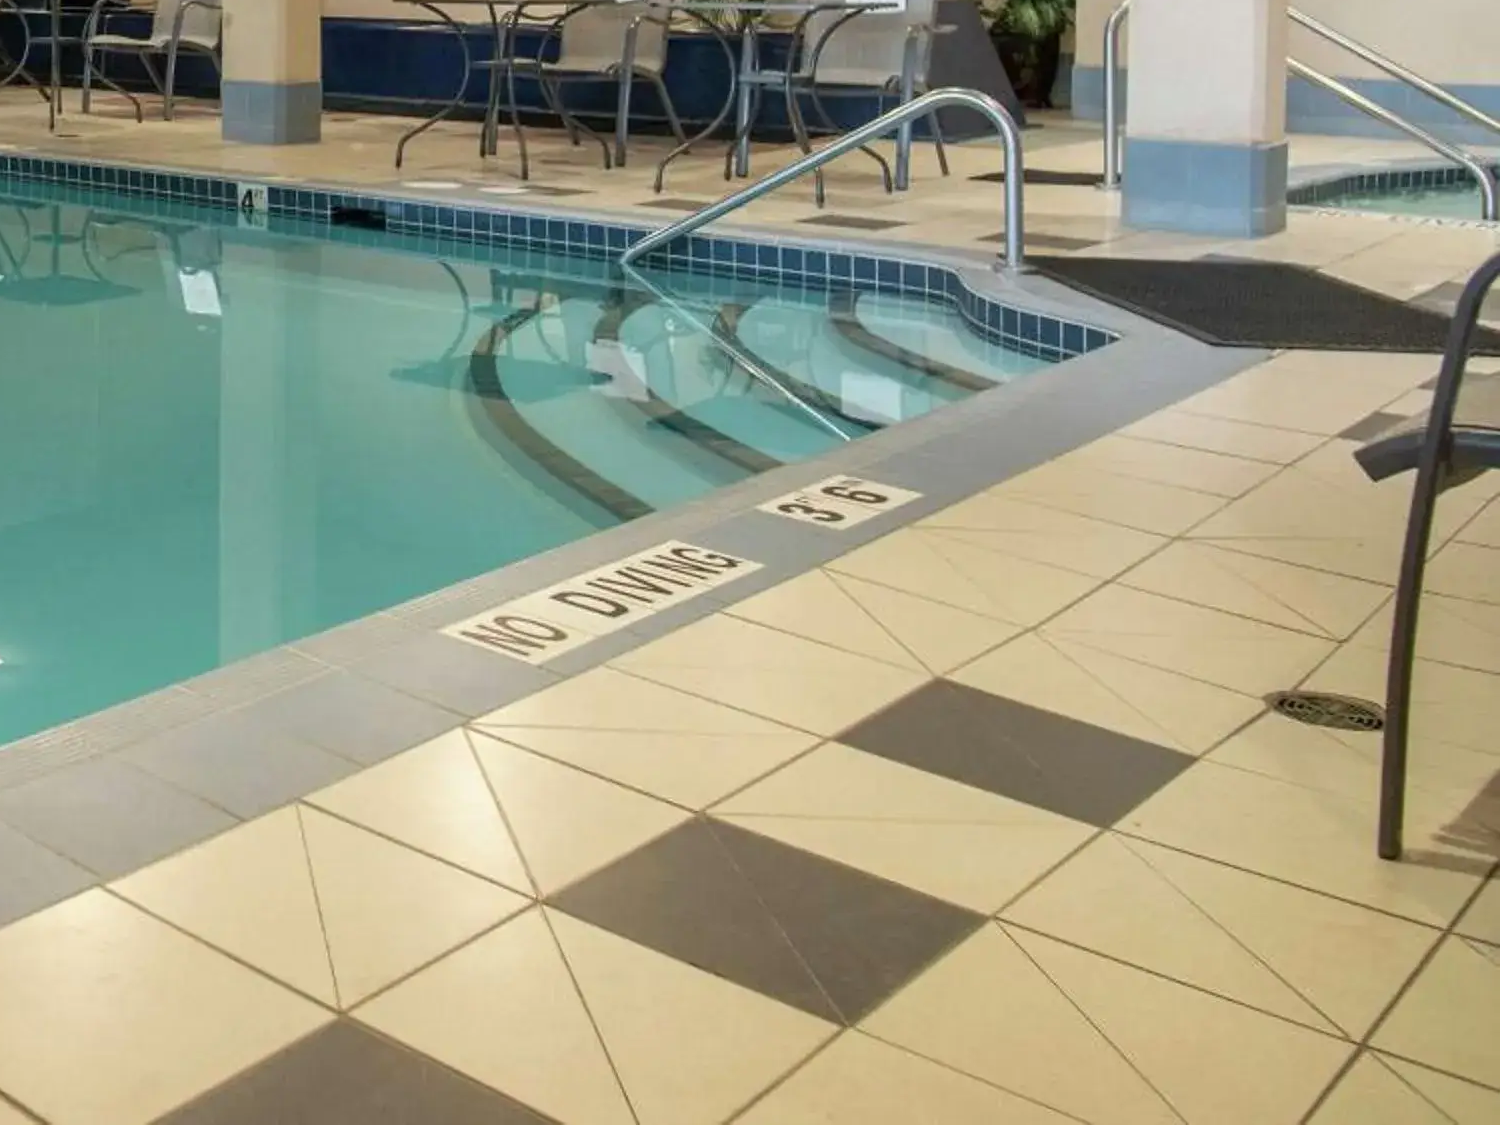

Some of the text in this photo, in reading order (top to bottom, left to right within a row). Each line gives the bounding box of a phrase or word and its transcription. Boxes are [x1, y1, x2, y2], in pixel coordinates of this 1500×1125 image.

[241, 188, 254, 208] 4
[777, 503, 845, 522] 3
[821, 486, 889, 505] 6
[461, 547, 741, 656] NO DIVING
